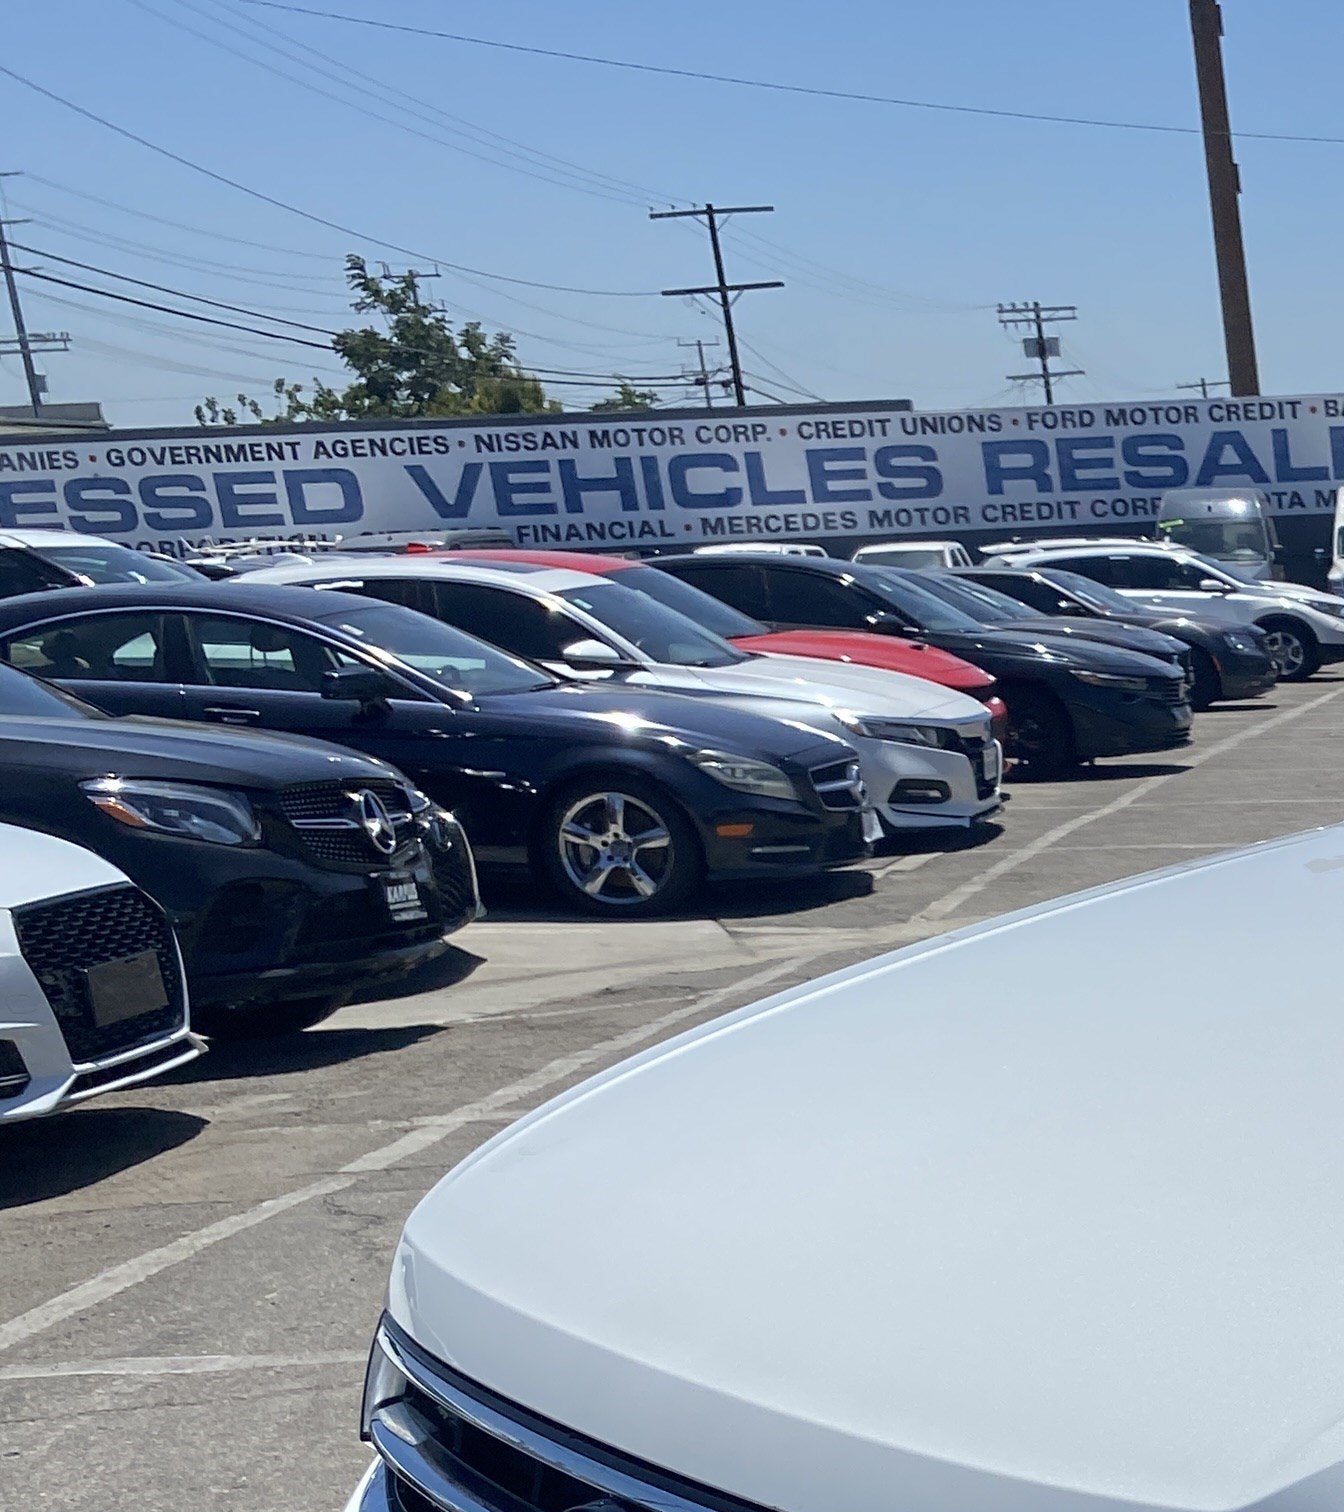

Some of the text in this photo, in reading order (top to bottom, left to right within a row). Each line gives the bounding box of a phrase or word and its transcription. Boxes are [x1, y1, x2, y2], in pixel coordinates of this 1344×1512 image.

[106, 441, 301, 467] GOVERNMENT
[313, 435, 450, 460] AGENCIES
[474, 430, 580, 453] NISSAN
[588, 426, 686, 449] MOTOR
[694, 423, 772, 445] CORP.
[797, 418, 891, 440] CREDIT
[901, 414, 1003, 435] UNIONS
[1026, 409, 1096, 431] FORD
[1104, 404, 1200, 427] MOTOR
[1208, 399, 1302, 423] CREDIT
[404, 444, 943, 518] VEHICLES
[516, 519, 675, 543] FINANCIAL
[700, 510, 858, 535] MERCEDES
[869, 505, 971, 529] MOTOR
[981, 500, 1081, 523] CREDIT
